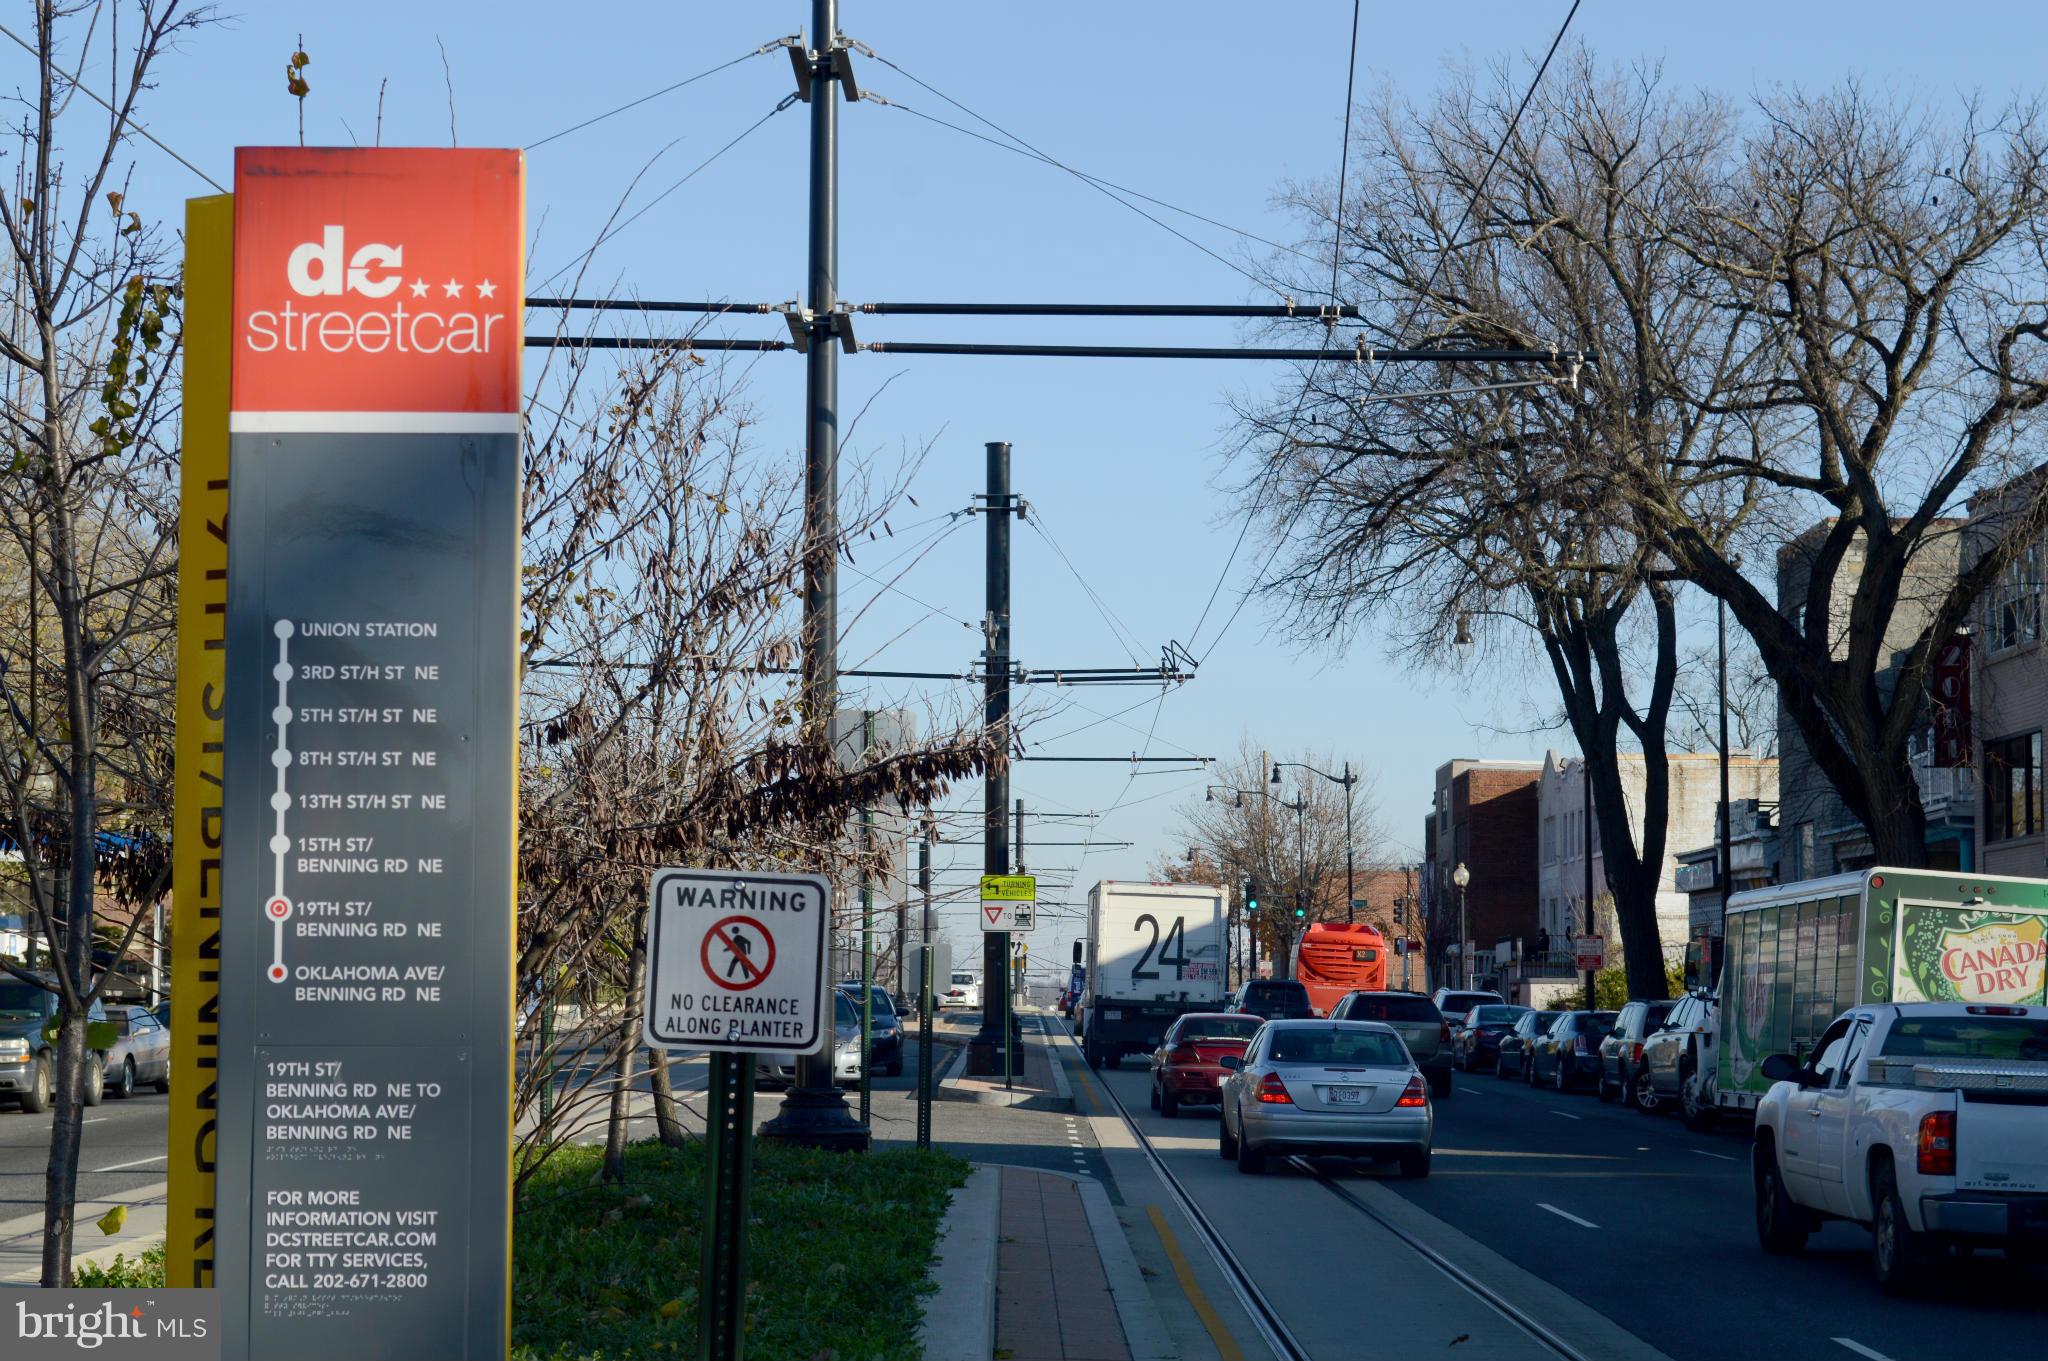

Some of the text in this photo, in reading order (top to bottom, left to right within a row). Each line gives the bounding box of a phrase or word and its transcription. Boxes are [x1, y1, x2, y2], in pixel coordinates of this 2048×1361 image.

[247, 300, 504, 354] streetcar
[301, 622, 437, 637] UNION STATION
[301, 665, 439, 680] 3RD ST/H ST NE
[300, 708, 437, 723] 5TH ST/H ST NE
[299, 751, 436, 766] 8TH ST/H ST NE
[299, 794, 446, 809] 13TH ST/H ST NE
[298, 837, 374, 852] 15TH ST/
[297, 858, 443, 873] BENNING RD NE
[1003, 880, 1031, 888] TURNING
[676, 886, 806, 913] WARNING
[297, 901, 372, 916] 19TH ST/
[296, 923, 442, 937] BENNING RD NE
[1132, 913, 1191, 981] 24
[1941, 939, 2048, 981] CANADA
[295, 965, 445, 981] OKLAHOMA AVE/
[1975, 965, 2029, 995] DRY
[295, 987, 441, 1002] BENNING RD NE
[671, 993, 800, 1016] NO CLEARANCE
[665, 1016, 804, 1039] ALONG PLANTER
[267, 1062, 342, 1077] 19TH ST/
[266, 1083, 441, 1098] BENNING RD NE TO
[266, 1104, 416, 1119] OKLAHOMA AVE/
[266, 1126, 412, 1140] BENNING RD NE
[267, 1191, 360, 1205] FOR MORE
[266, 1211, 439, 1226] INFORMATION VISIT
[266, 1232, 437, 1247] DCSTREETCAR.COM
[266, 1253, 428, 1269] FOR TTY SERVICES,
[265, 1274, 428, 1289] CALL 202-671-2800
